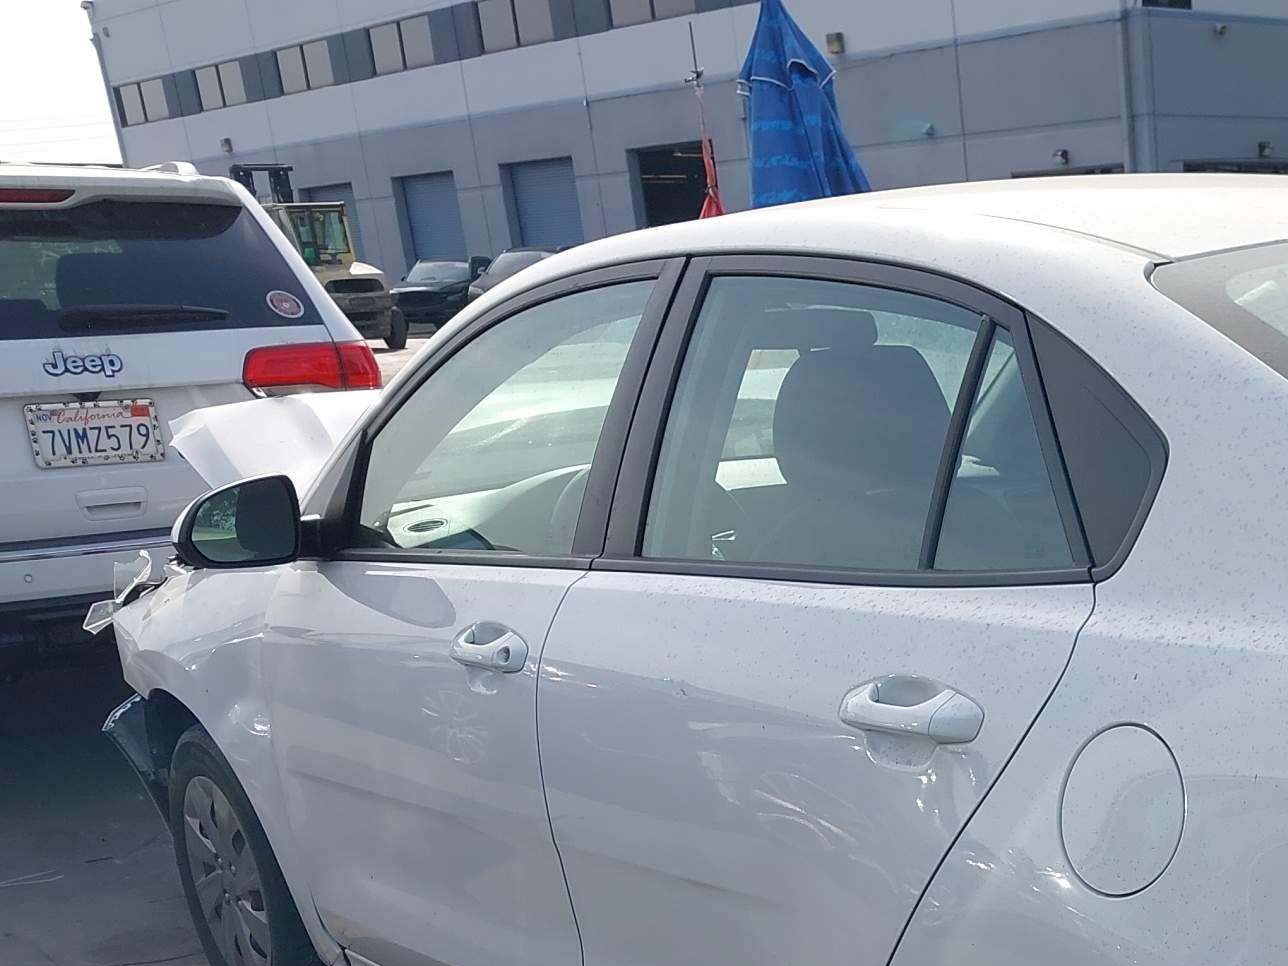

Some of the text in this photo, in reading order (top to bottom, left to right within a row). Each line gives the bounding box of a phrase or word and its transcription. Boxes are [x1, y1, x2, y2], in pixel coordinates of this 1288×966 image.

[43, 350, 122, 377] Jeep
[57, 408, 131, 425] California
[42, 423, 150, 456] 7VMZ579
